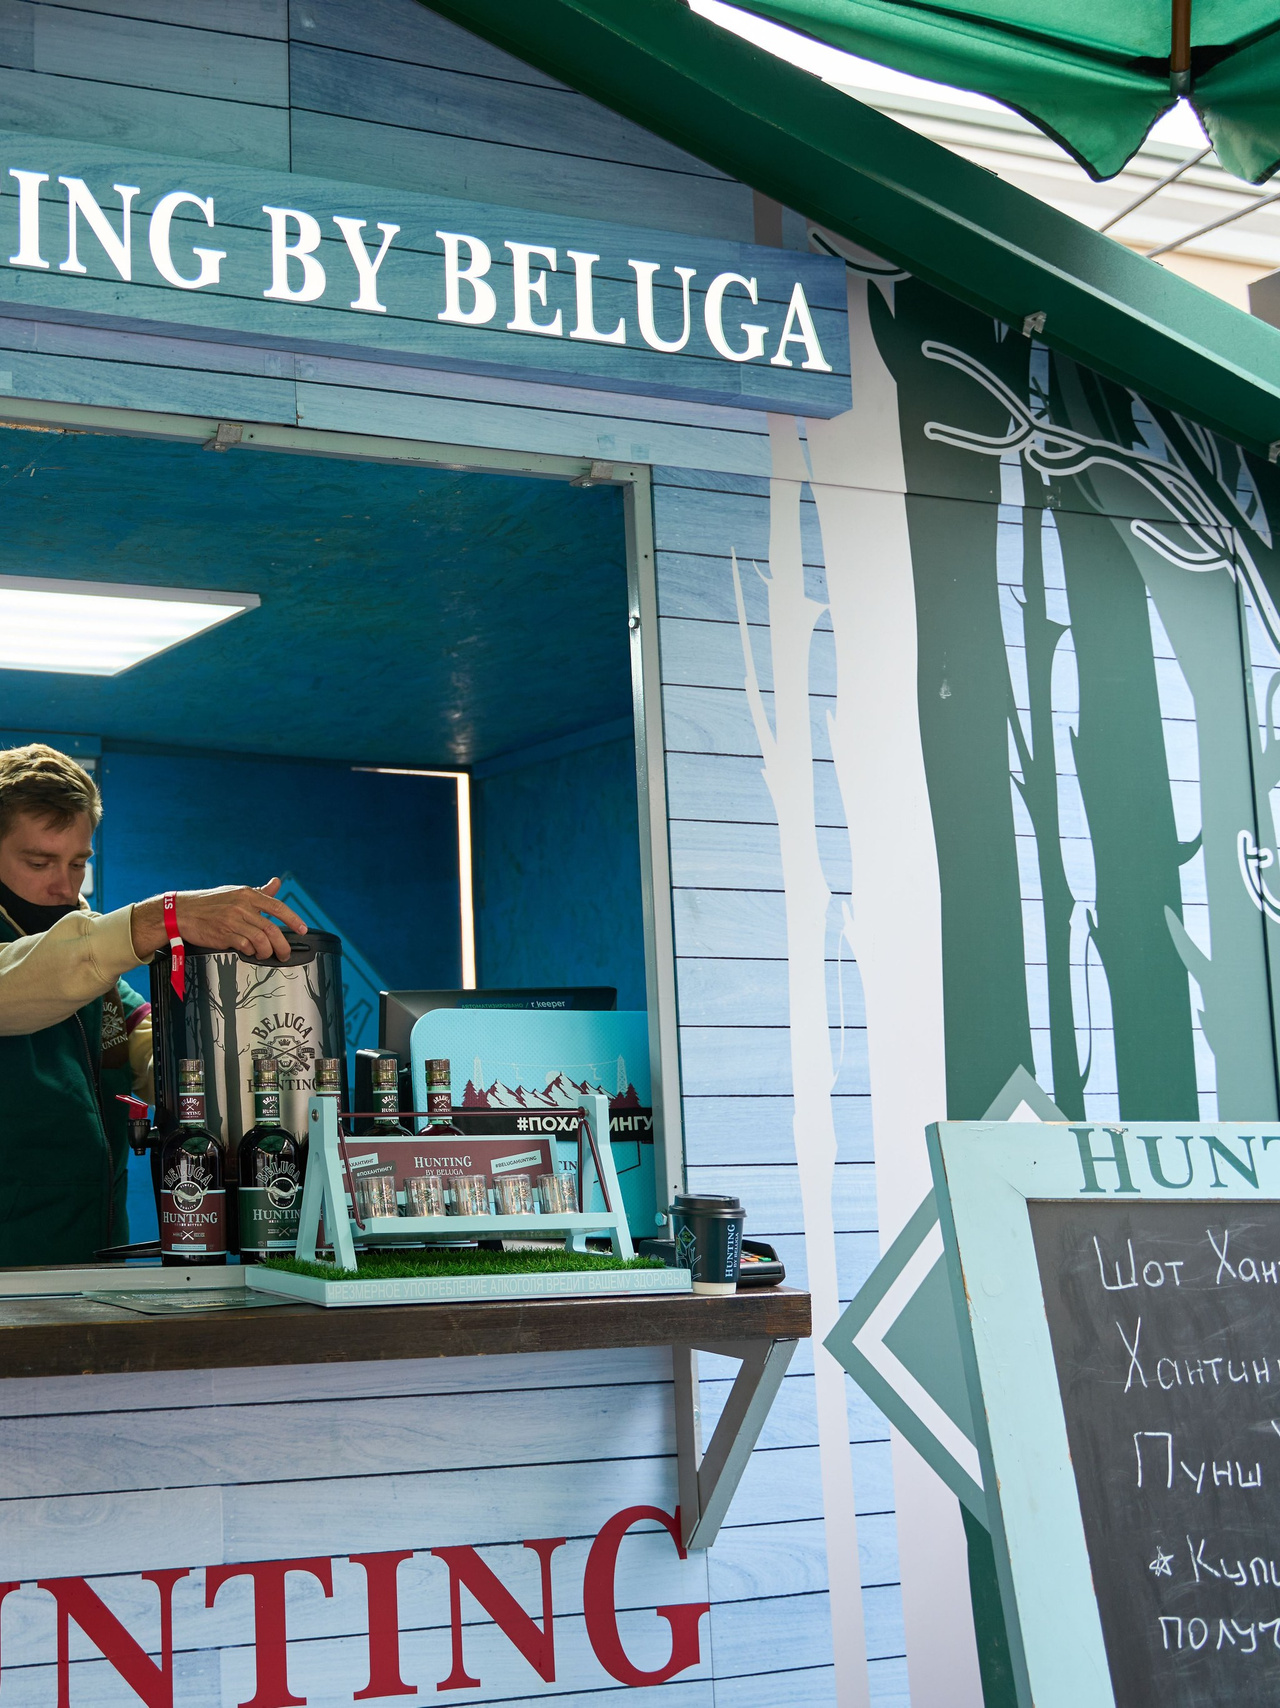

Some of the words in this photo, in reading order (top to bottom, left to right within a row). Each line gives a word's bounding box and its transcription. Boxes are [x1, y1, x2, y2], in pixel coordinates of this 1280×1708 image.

[261, 204, 402, 313] BY
[435, 230, 833, 373] BELUGA
[251, 1012, 313, 1040] BELUGA
[246, 1078, 317, 1094] HNTIN
[517, 1116, 653, 1132] #ПОХАИНГУ
[255, 1160, 301, 1184] BELUGA
[341, 1158, 374, 1169] #АХАНТИНГ
[413, 1155, 473, 1169] HUNTING
[436, 1168, 464, 1176] BELUGA
[495, 1155, 537, 1168] #BELUGAHUNTING
[163, 1163, 214, 1188] BELUGA
[163, 1211, 218, 1224] HUNTING
[252, 1208, 301, 1221] HUNTIN
[725, 1224, 736, 1277] HUNTING
[1092, 1235, 1184, 1291] Шот
[1205, 1228, 1280, 1284] Хан
[326, 1281, 401, 1300] ЧРЕЗМЕРНОЕ
[402, 1278, 488, 1298] УПОТРЕБЛЕНИЕ
[489, 1275, 544, 1293] АЛКОГОЛЯ
[546, 1273, 586, 1292] ВРЕДИТ
[588, 1272, 632, 1290] ВАШЕМУ
[633, 1270, 689, 1289] ЗДОРОВЬЮ
[1116, 1315, 1280, 1393] Хантин
[1133, 1431, 1262, 1494] Пунш
